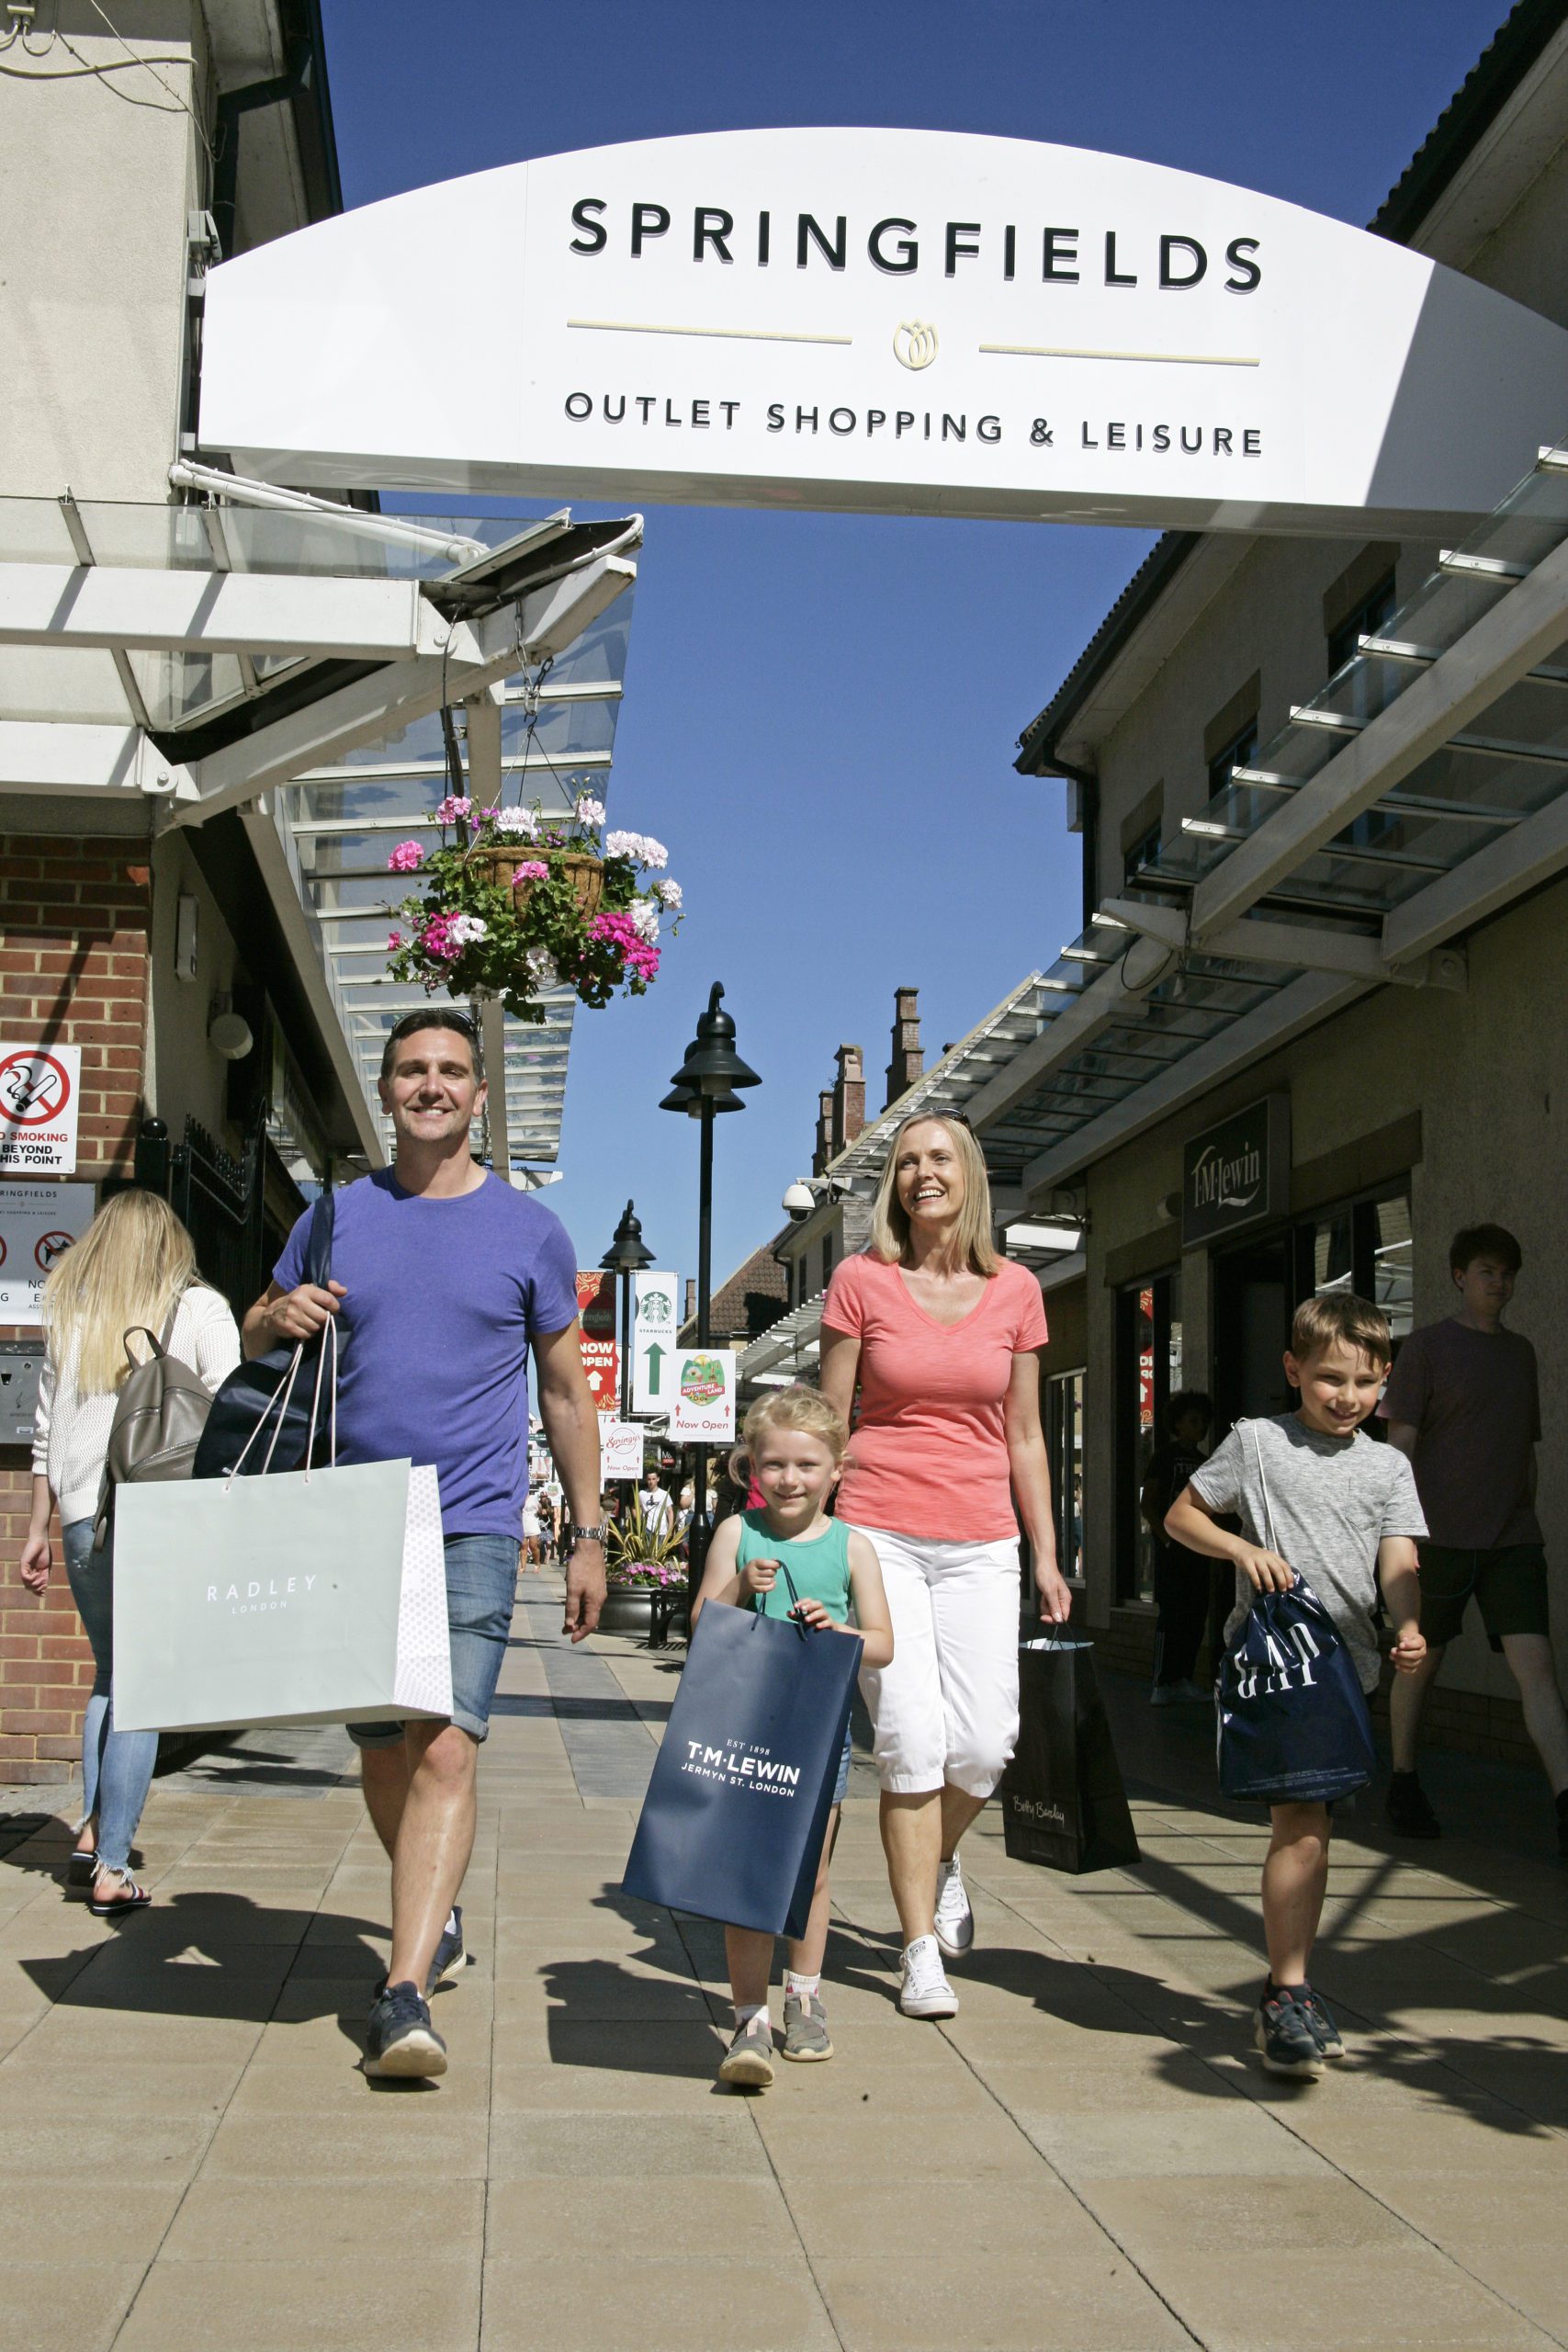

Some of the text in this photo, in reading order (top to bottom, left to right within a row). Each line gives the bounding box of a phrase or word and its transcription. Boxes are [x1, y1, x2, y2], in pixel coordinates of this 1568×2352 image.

[570, 198, 1262, 295] SPRINGFIELDS
[564, 391, 1263, 457] OUTLET SHOPPING & LEISURE
[10, 1132, 68, 1142] SMOKING
[2, 1144, 52, 1154] BEYOND
[0, 1154, 62, 1165] HIS POINT
[682, 1383, 715, 1394] ADVENTURE
[676, 1420, 728, 1430] Now Open
[207, 1575, 316, 1601] RADLEY
[231, 1600, 288, 1614] LONDON
[727, 1738, 771, 1756] EST 1898
[681, 1762, 795, 1798] JERMYN ST. LONDON
